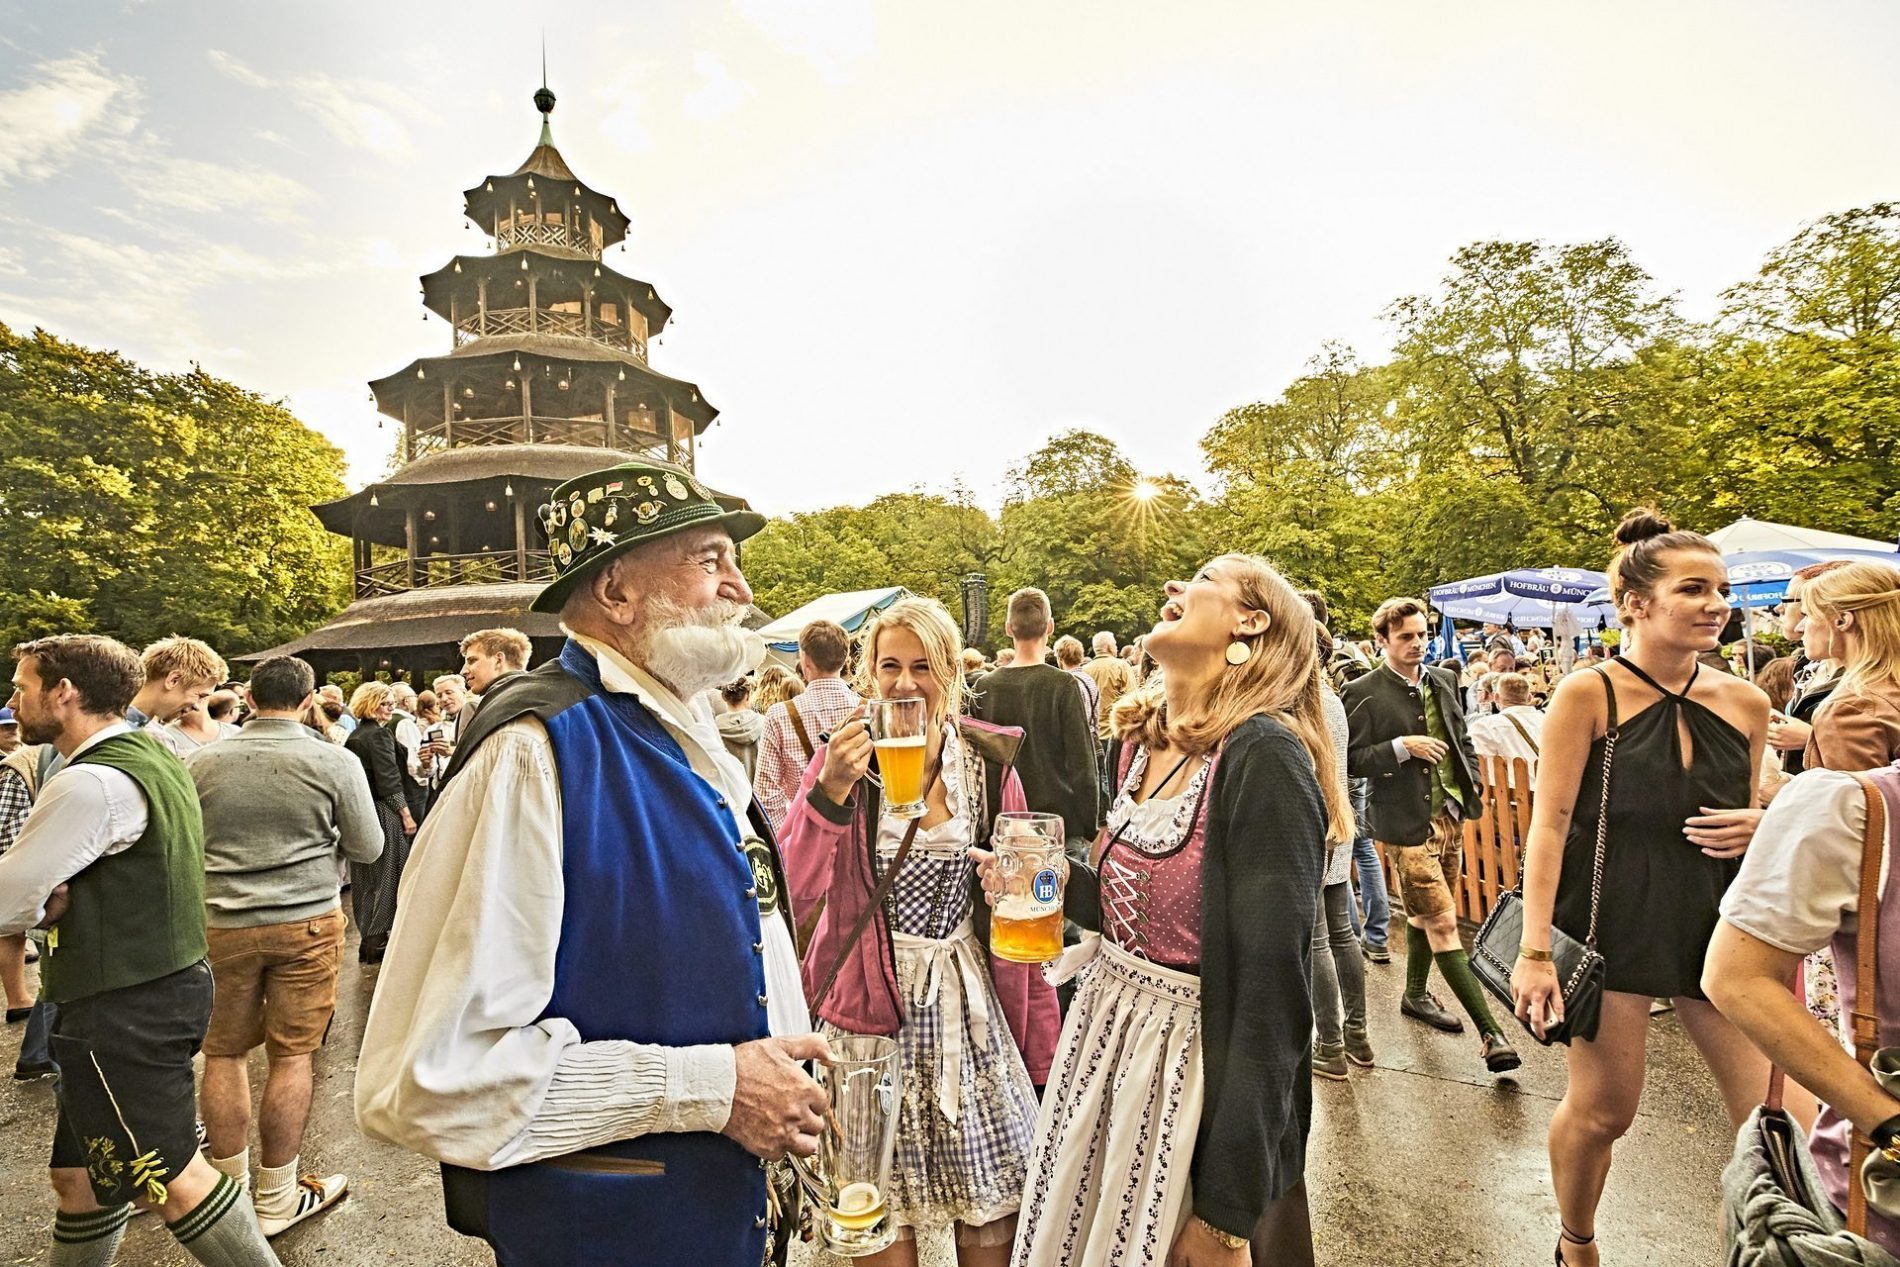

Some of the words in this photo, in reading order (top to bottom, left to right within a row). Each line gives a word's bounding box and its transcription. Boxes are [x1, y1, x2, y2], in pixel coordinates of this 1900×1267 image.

[1467, 581, 1497, 593] MÜNCHEN
[1510, 581, 1549, 592] HOFBRÄU
[1562, 587, 1592, 597] MÜNC
[1039, 885, 1053, 899] HB
